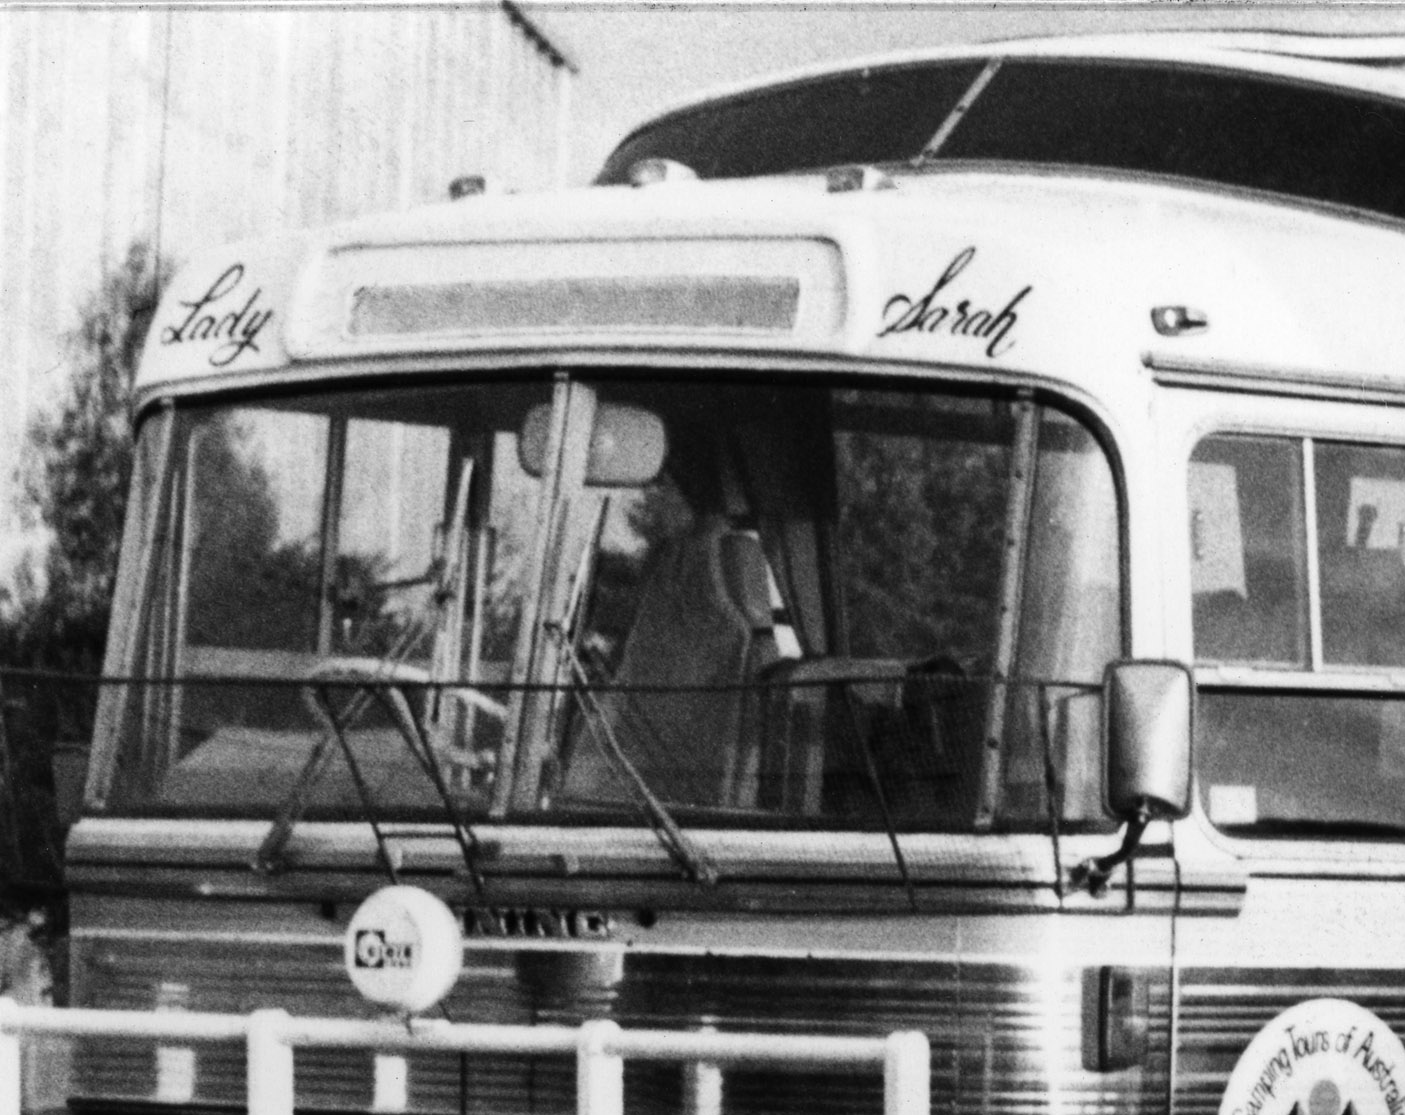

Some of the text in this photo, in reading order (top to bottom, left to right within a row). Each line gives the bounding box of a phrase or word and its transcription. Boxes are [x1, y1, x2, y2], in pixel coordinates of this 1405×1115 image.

[161, 246, 1032, 367] Lady Sarah
[1284, 1024, 1331, 1061] Tours
[1335, 1025, 1357, 1054] of
